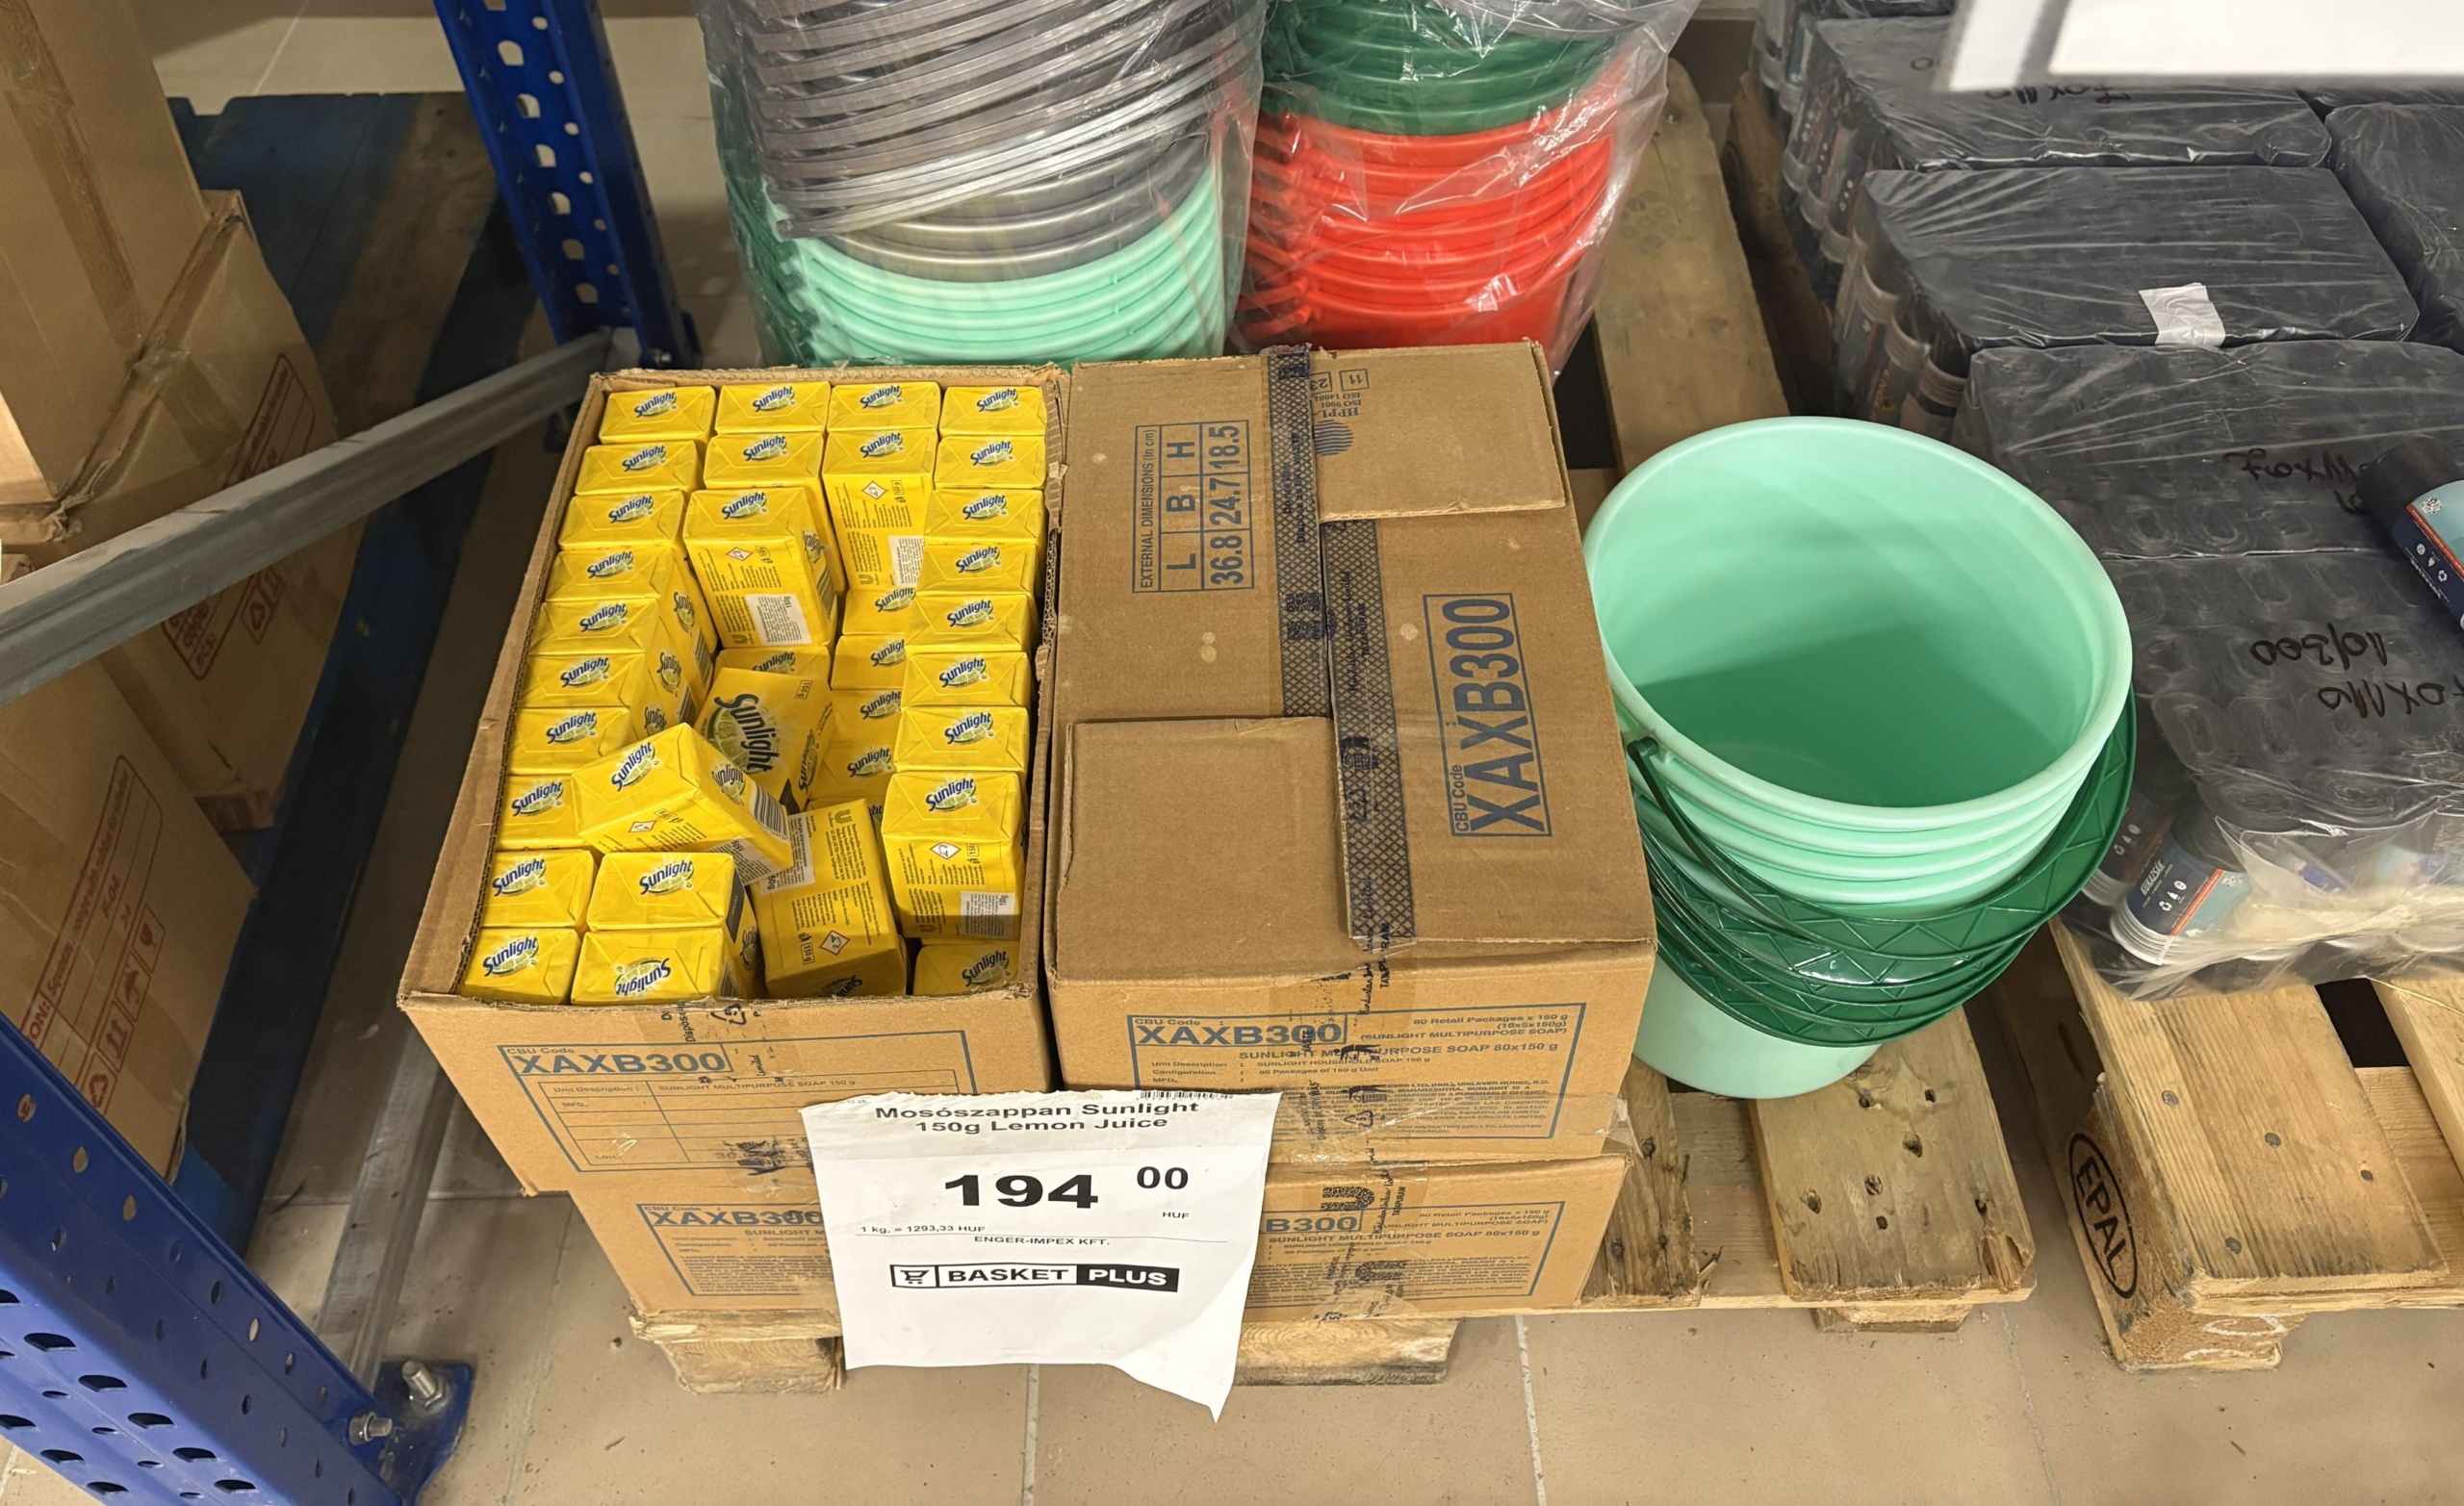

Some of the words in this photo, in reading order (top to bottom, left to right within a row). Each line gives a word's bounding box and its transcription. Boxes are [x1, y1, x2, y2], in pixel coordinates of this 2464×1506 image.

[1348, 373, 1363, 384] 11
[634, 392, 676, 418] Sunlight
[752, 386, 793, 413] Sunlight
[860, 385, 902, 409] Sunlight
[976, 387, 1018, 412] Sunlight
[743, 436, 785, 461] Sunlight
[860, 433, 903, 458] Sunlight
[1143, 428, 1156, 446] cm)
[1166, 441, 1195, 458] H
[1208, 424, 1241, 470] 18.5
[622, 445, 666, 472] Sunlight
[970, 440, 1013, 467] Sunlight
[722, 492, 765, 520] Sunlight
[962, 495, 1006, 520] Sunlight
[1140, 461, 1154, 527] DIMENSIONS
[1166, 494, 1196, 512] B
[1208, 477, 1242, 525] 24.7
[608, 496, 654, 523] Sunlight
[587, 550, 632, 578] Sunlight
[956, 546, 1000, 574] Sunlight
[1140, 529, 1154, 588] EXTERNAL
[1167, 552, 1196, 570] L
[1209, 535, 1244, 585] 36.8
[579, 603, 627, 632] Sunlight
[947, 599, 993, 627] Sunlight
[870, 639, 905, 667] Sunlig
[560, 657, 610, 687] Sunlight
[938, 658, 986, 688] Sunlight
[860, 690, 902, 720] Sunlight
[1443, 599, 1546, 832] XAXB300
[546, 711, 597, 745] Sunlight
[714, 693, 781, 774] Sunlight
[944, 712, 993, 745] Sunlight
[611, 742, 654, 792] Sunlight
[847, 748, 890, 779] Sunlight
[1451, 764, 1465, 798] Code
[511, 781, 563, 817] Sunlight
[925, 779, 975, 812] Sunlight
[1454, 804, 1471, 832] CBU
[492, 858, 546, 897] Sunlight
[639, 859, 693, 895] Sunlight
[767, 875, 776, 890] 50g
[2139, 859, 2166, 896] KUKAZSÁK
[483, 936, 539, 977] Sunlight
[962, 951, 1009, 987] Sunlight
[615, 957, 672, 996] Sunlight
[1466, 1015, 1524, 1025] Packages
[1137, 1024, 1342, 1046] XAXB300
[1360, 1032, 1426, 1041] (SUNLIGHT
[1429, 1029, 1527, 1039] MULTIPURPOSE
[1529, 1028, 1568, 1036] SOAP)
[1447, 1043, 1490, 1054] SOAP
[1494, 1042, 1545, 1053] 80x150
[1548, 1042, 1558, 1052] g
[512, 1052, 725, 1075] XAXB300
[540, 1046, 576, 1055] Code
[577, 1085, 633, 1093] Description
[658, 1084, 710, 1092] SUNLIGHT
[712, 1082, 796, 1090] MULTIPURPOSE
[875, 1105, 1071, 1120] Mosószappan
[1081, 1101, 1199, 1115] Sunlight
[913, 1121, 980, 1136] 150g
[990, 1119, 1086, 1133] Lemon
[1093, 1116, 1168, 1131] Juice
[943, 1173, 1099, 1210] 194
[1136, 1165, 1190, 1190] 00
[1162, 1210, 1190, 1219] HUF
[1266, 1215, 1358, 1233] B300
[1431, 1219, 1519, 1228] MULTIPURPOSE
[2075, 1156, 2128, 1268] EPAL
[906, 1225, 955, 1235] 1293,33
[974, 1236, 1076, 1246] ENGER-IMPEX
[1078, 1238, 1111, 1247] KFT.
[1269, 1235, 1335, 1243] SUNLIGHT
[1339, 1232, 1442, 1242] MULTIPURPOSE
[1445, 1231, 1483, 1239] SOAP
[1533, 1229, 1541, 1238] g
[947, 1268, 1069, 1283] BASKET
[1089, 1268, 1168, 1287] PLUS
